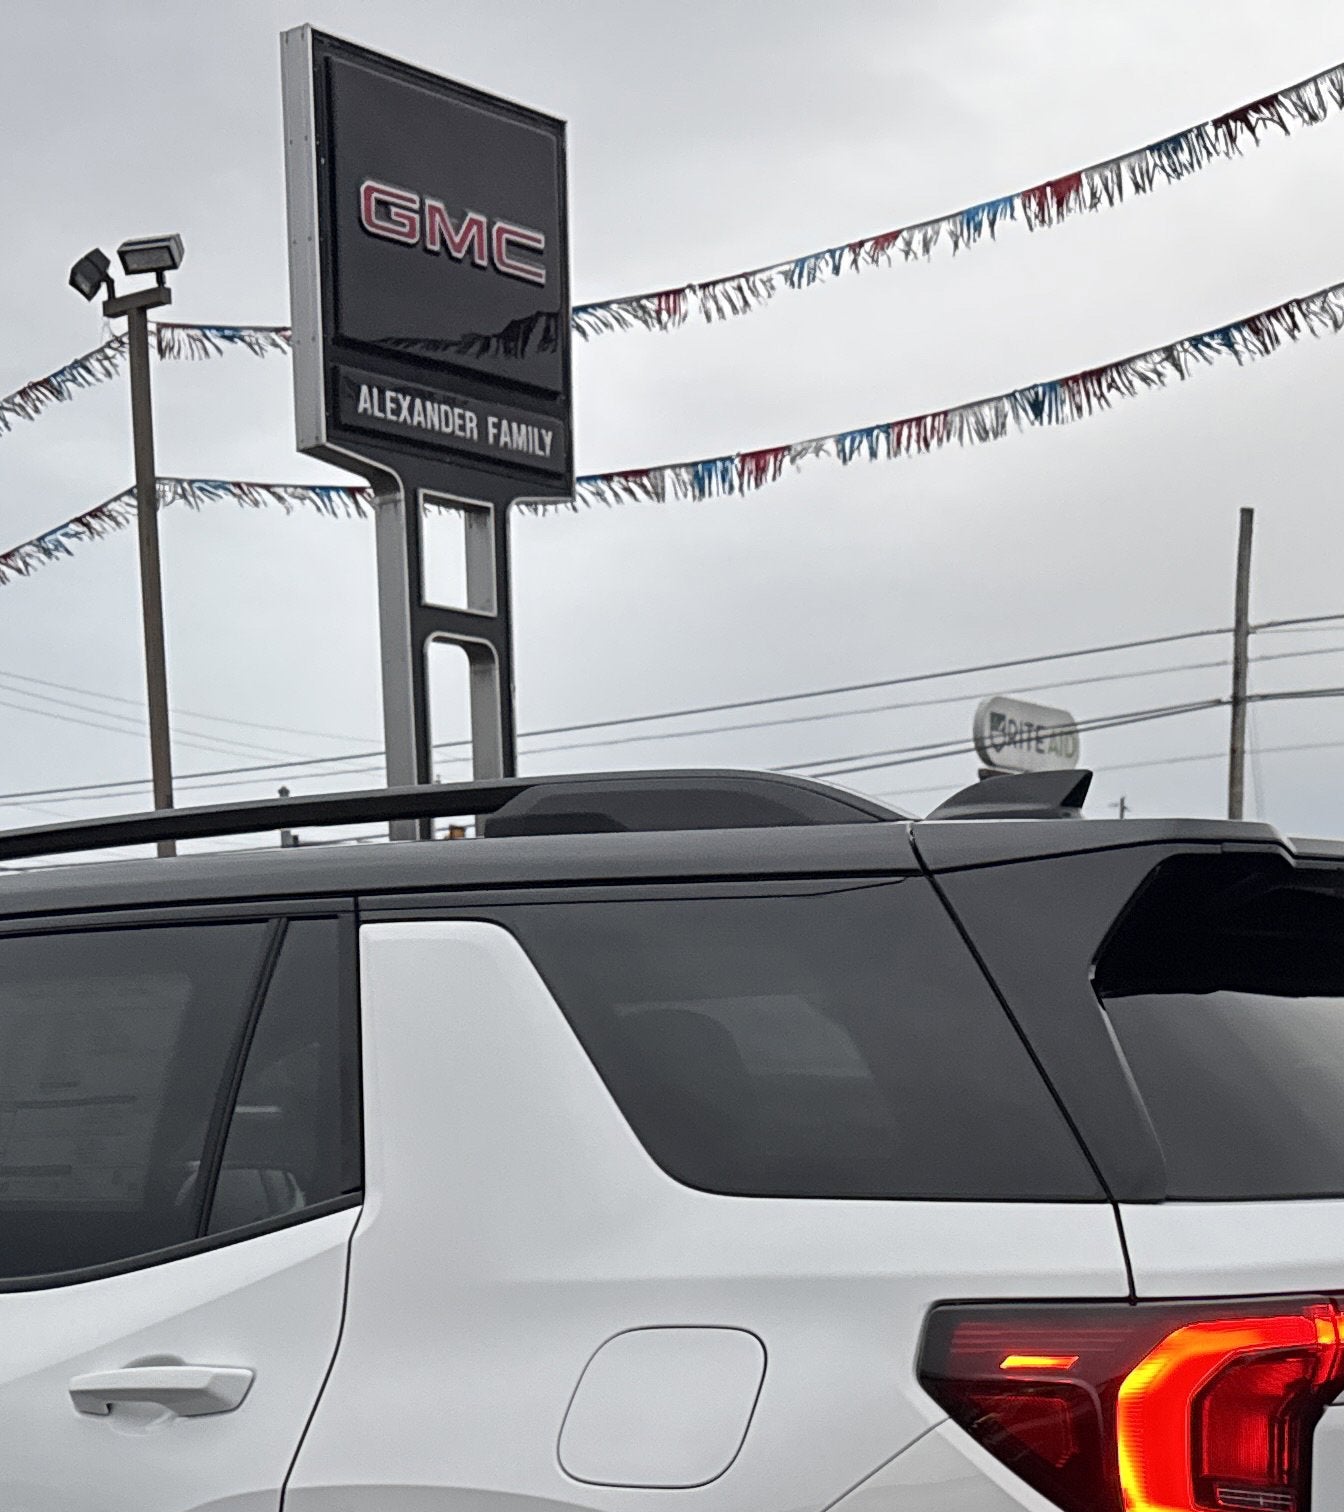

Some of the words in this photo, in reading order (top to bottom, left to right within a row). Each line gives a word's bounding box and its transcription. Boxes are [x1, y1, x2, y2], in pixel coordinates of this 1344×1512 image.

[359, 179, 546, 284] GMC
[357, 384, 479, 442] ALEXANDER
[487, 416, 554, 458] FAMILY
